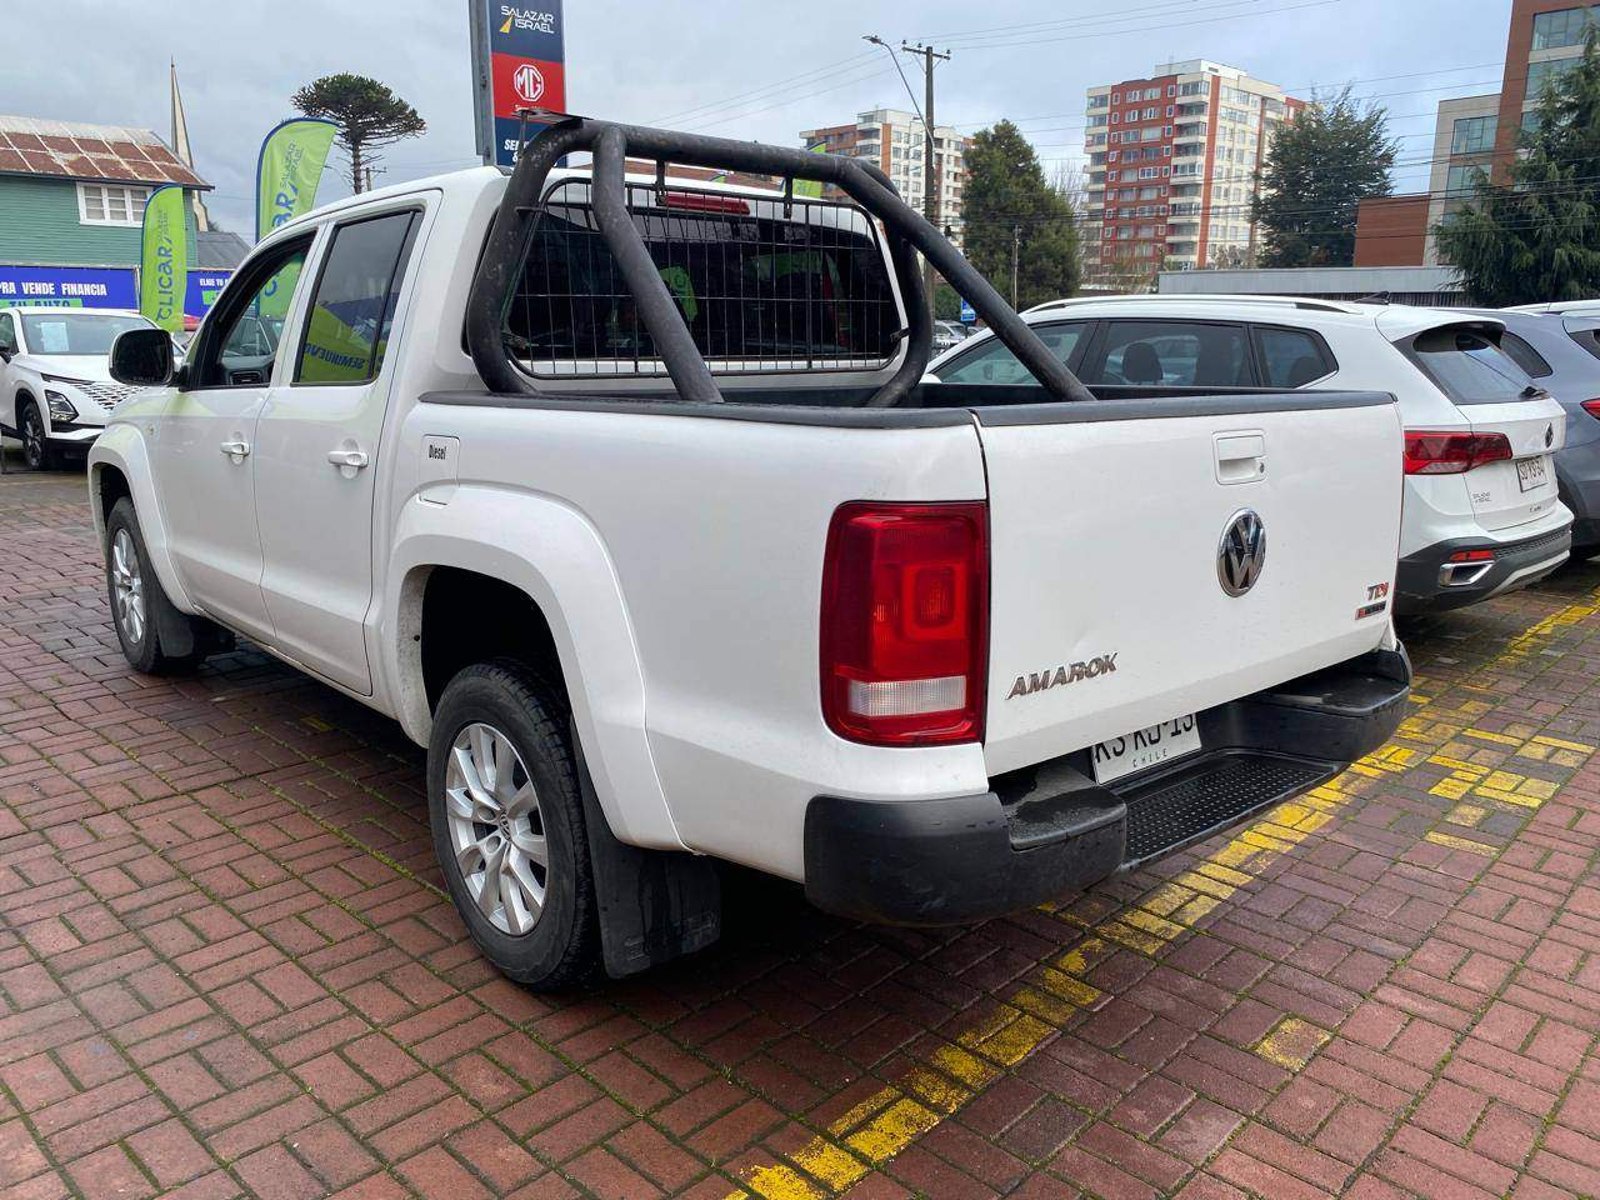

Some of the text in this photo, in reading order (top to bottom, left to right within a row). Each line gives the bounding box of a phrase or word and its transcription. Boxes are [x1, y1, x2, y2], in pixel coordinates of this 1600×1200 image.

[501, 5, 554, 24] SALAZAR
[515, 19, 555, 34] ISRAEL
[515, 66, 544, 101] MG
[22, 282, 55, 295] VENDE
[61, 283, 107, 296] FINANCIA
[1007, 652, 1118, 700] AMAROK
[1133, 748, 1167, 768] CHILE
